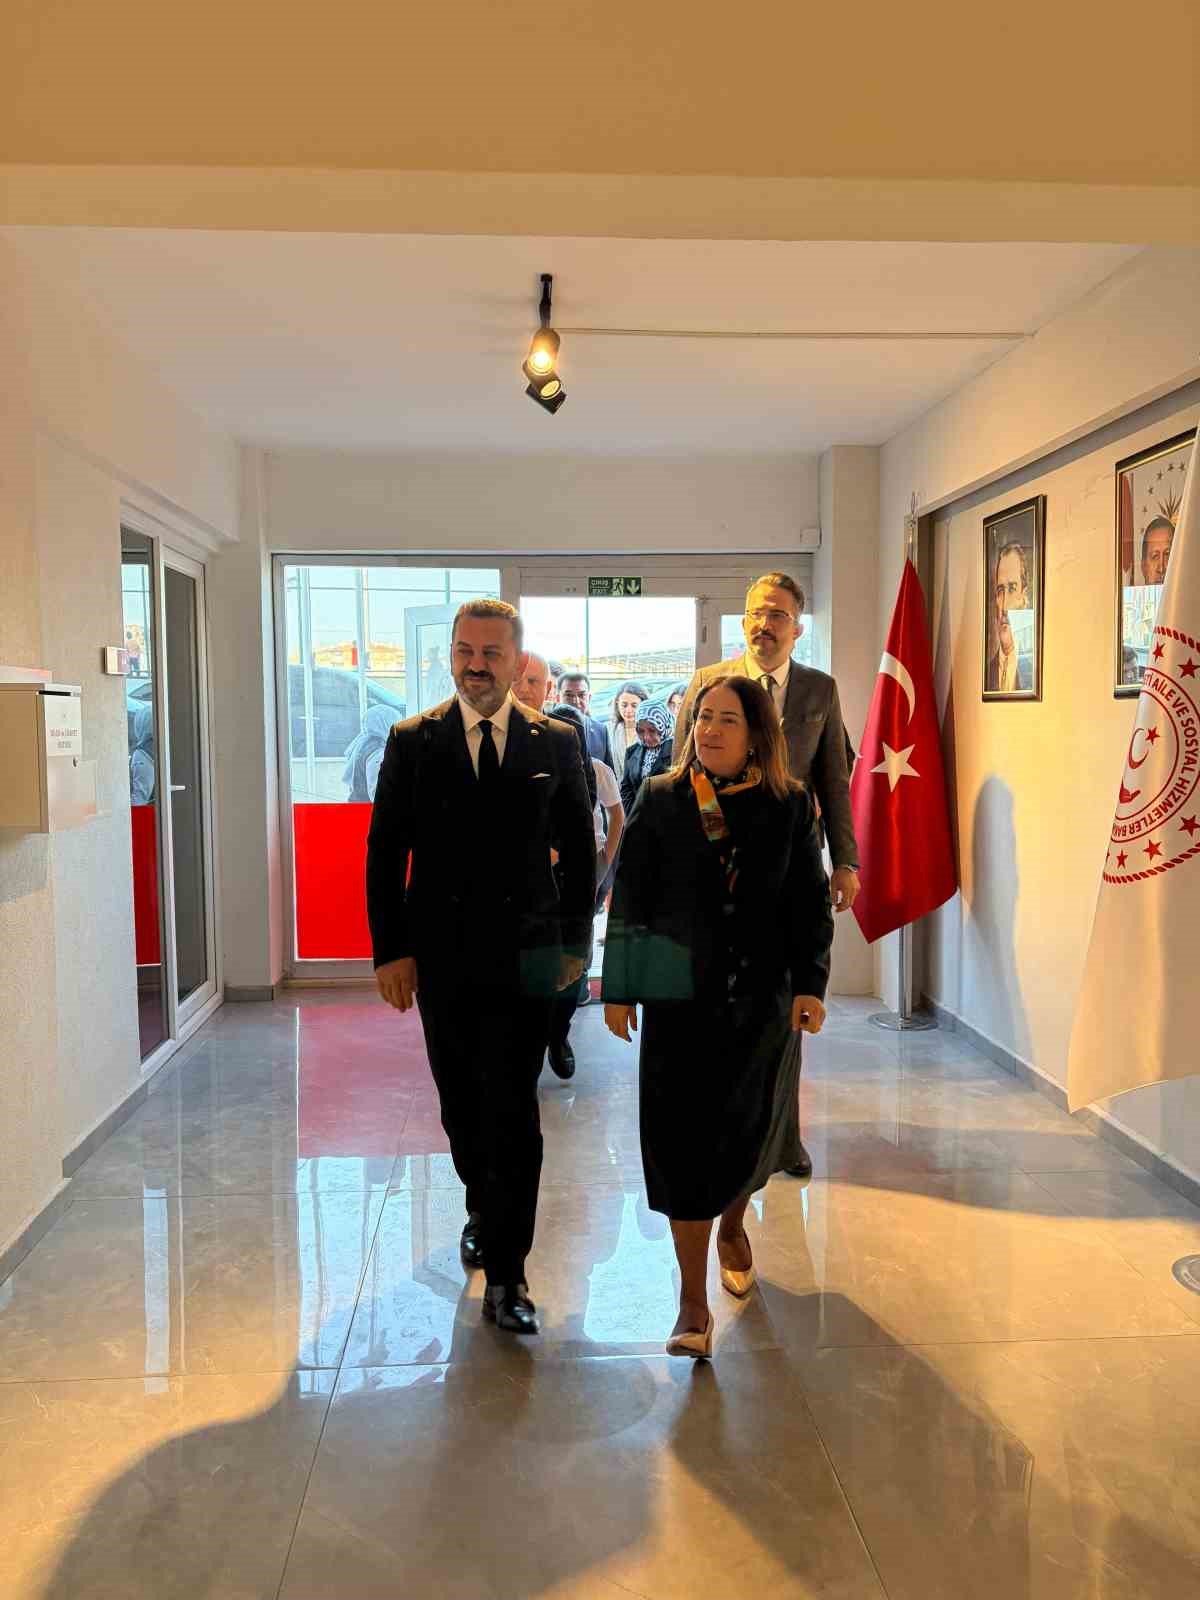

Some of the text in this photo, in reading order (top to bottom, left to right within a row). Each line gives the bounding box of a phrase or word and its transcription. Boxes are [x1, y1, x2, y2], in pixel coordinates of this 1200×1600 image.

[1152, 678, 1177, 702] AİLE
[1172, 697, 1190, 718] VE
[1180, 717, 1199, 774] SOSYAL
[1128, 776, 1191, 835] HİZMETLER
